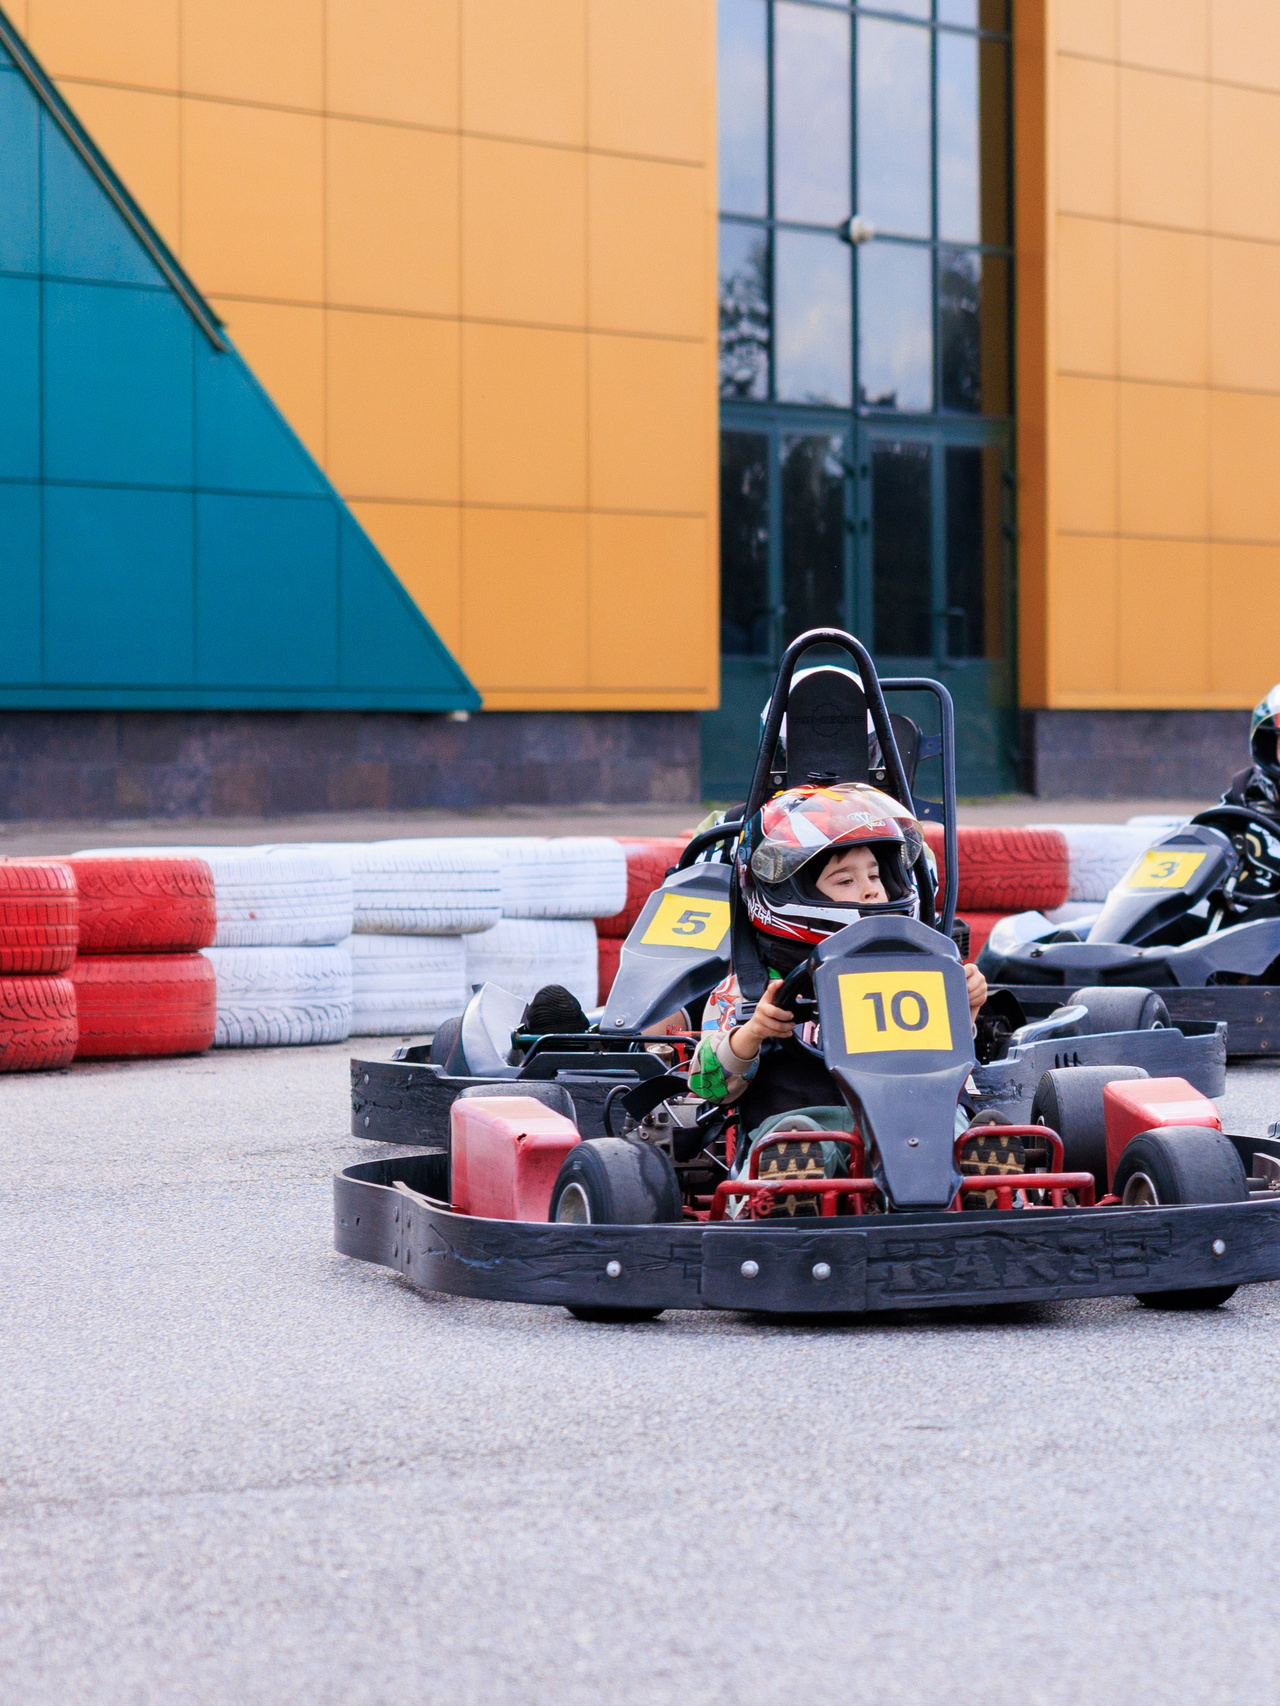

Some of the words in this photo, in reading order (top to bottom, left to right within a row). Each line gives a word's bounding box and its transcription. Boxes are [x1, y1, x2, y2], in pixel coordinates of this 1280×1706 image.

[1150, 861, 1180, 879] 3
[672, 909, 712, 936] 5
[862, 990, 930, 1032] 10
